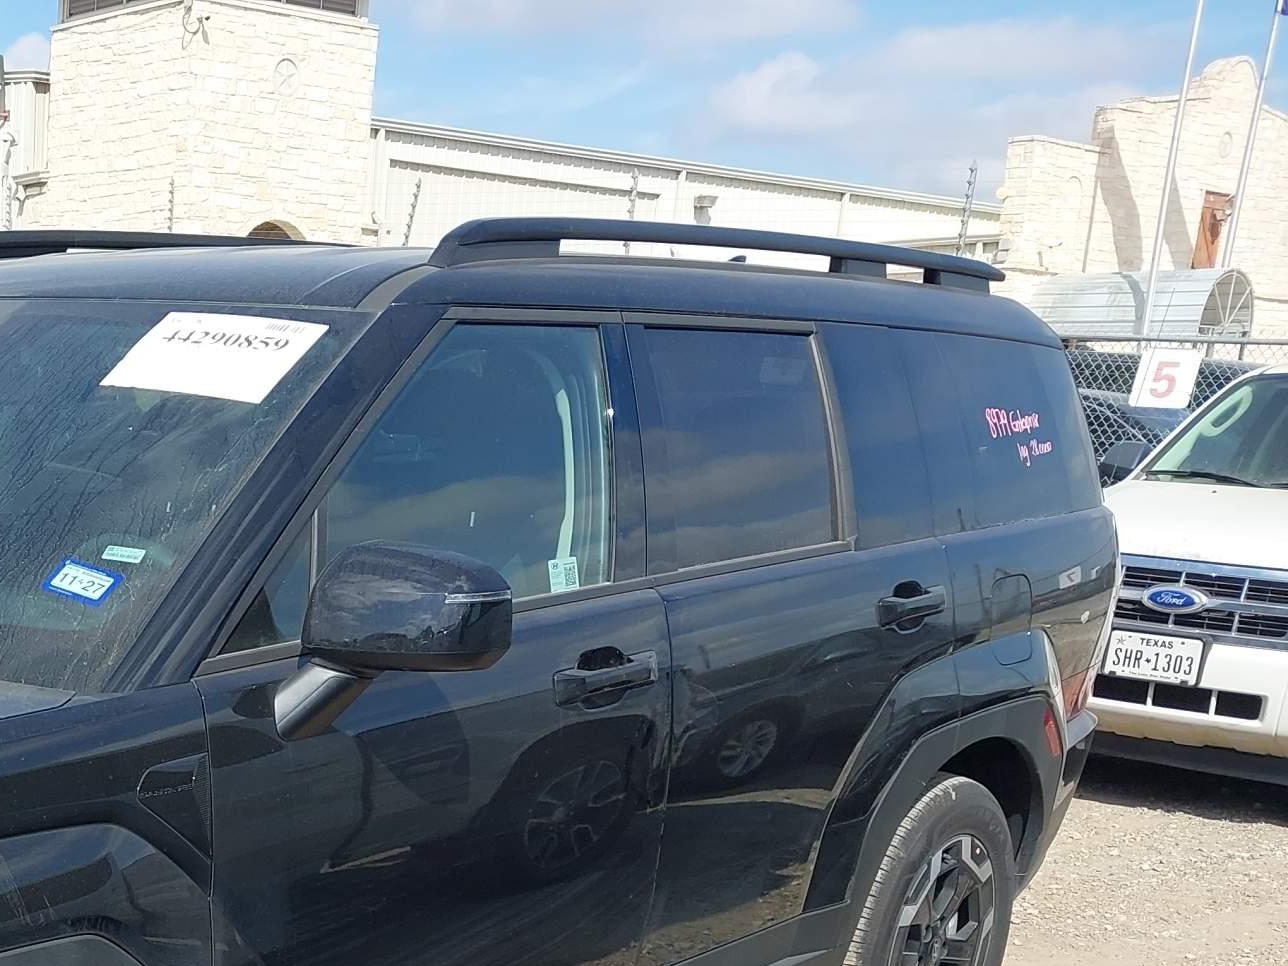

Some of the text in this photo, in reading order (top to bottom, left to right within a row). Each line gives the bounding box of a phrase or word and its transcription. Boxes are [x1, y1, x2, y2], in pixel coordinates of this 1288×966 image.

[162, 329, 289, 350] 44290859
[1149, 361, 1180, 398] 5
[1157, 592, 1187, 605] Ford
[1140, 637, 1174, 649] TEXAS
